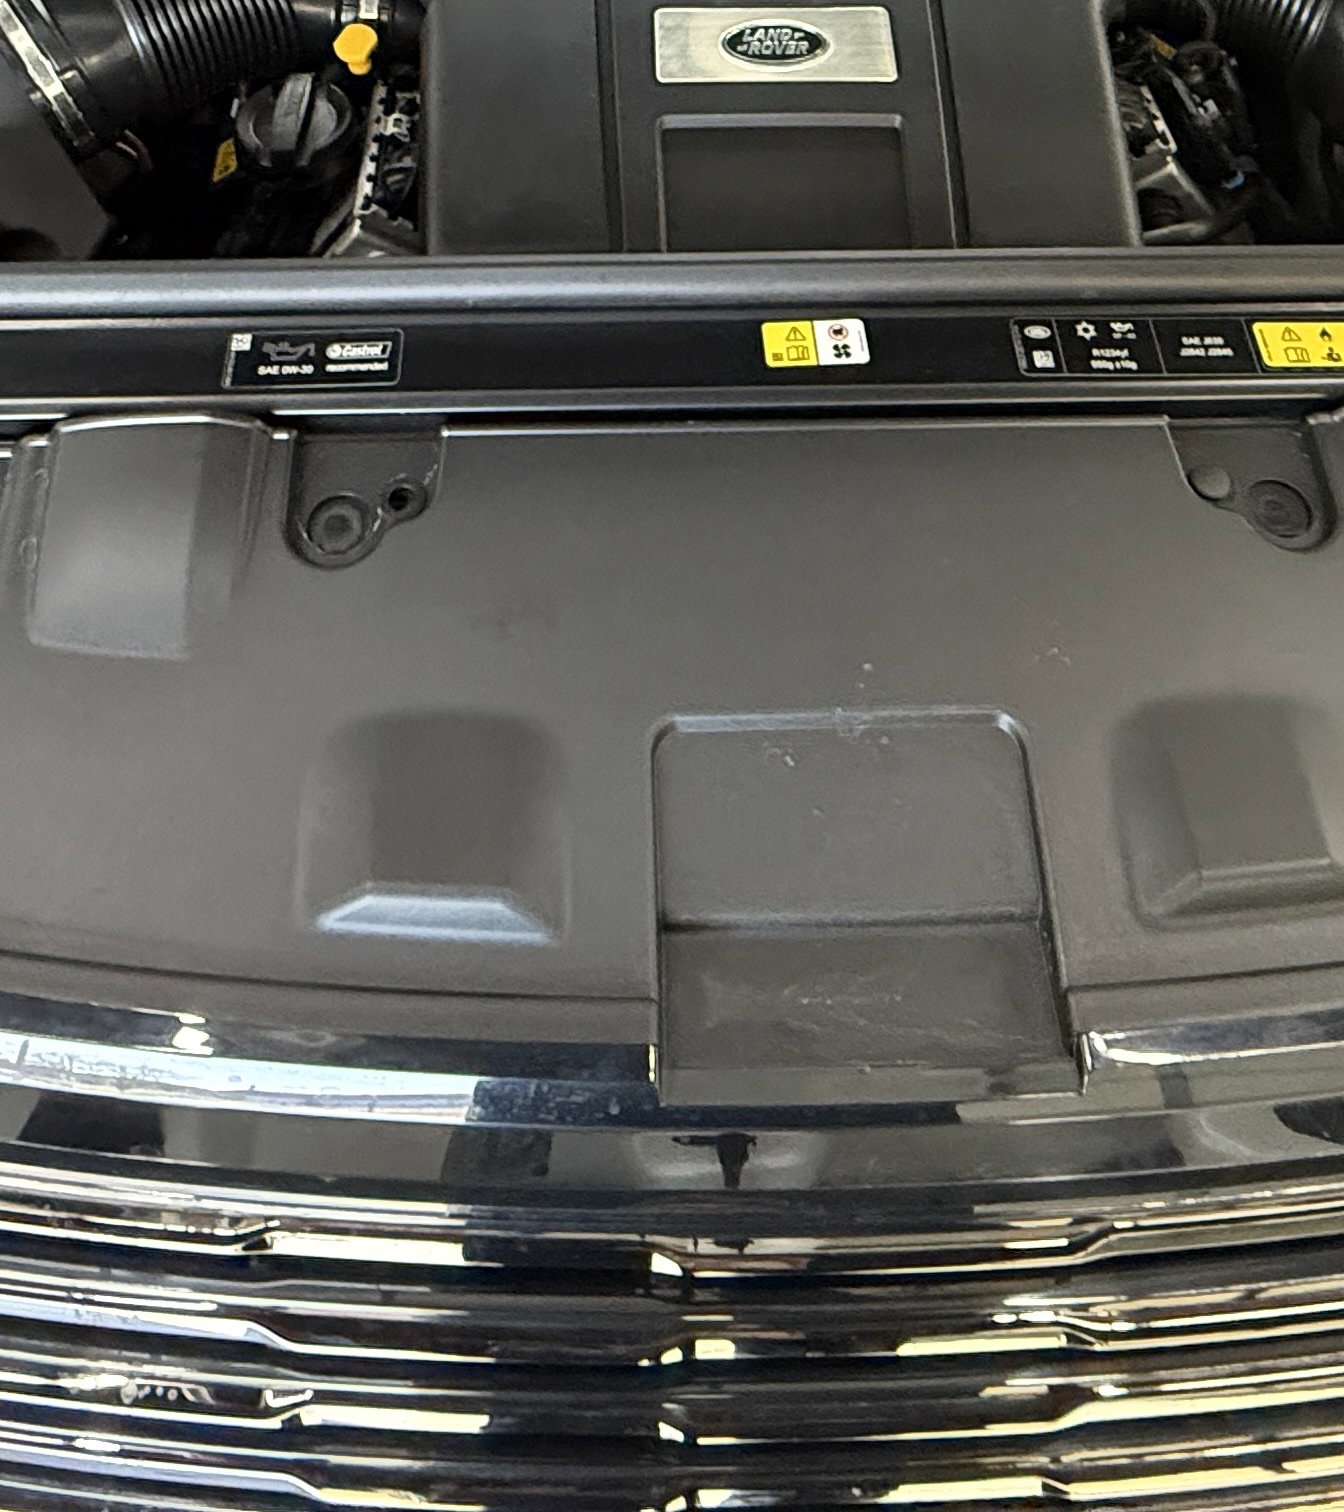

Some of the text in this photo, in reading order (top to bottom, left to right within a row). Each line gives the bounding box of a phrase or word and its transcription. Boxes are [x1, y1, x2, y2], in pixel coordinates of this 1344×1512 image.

[742, 28, 793, 42] LAND
[747, 40, 810, 55] ROVER
[342, 344, 384, 357] Castrol
[257, 364, 280, 375] SAE
